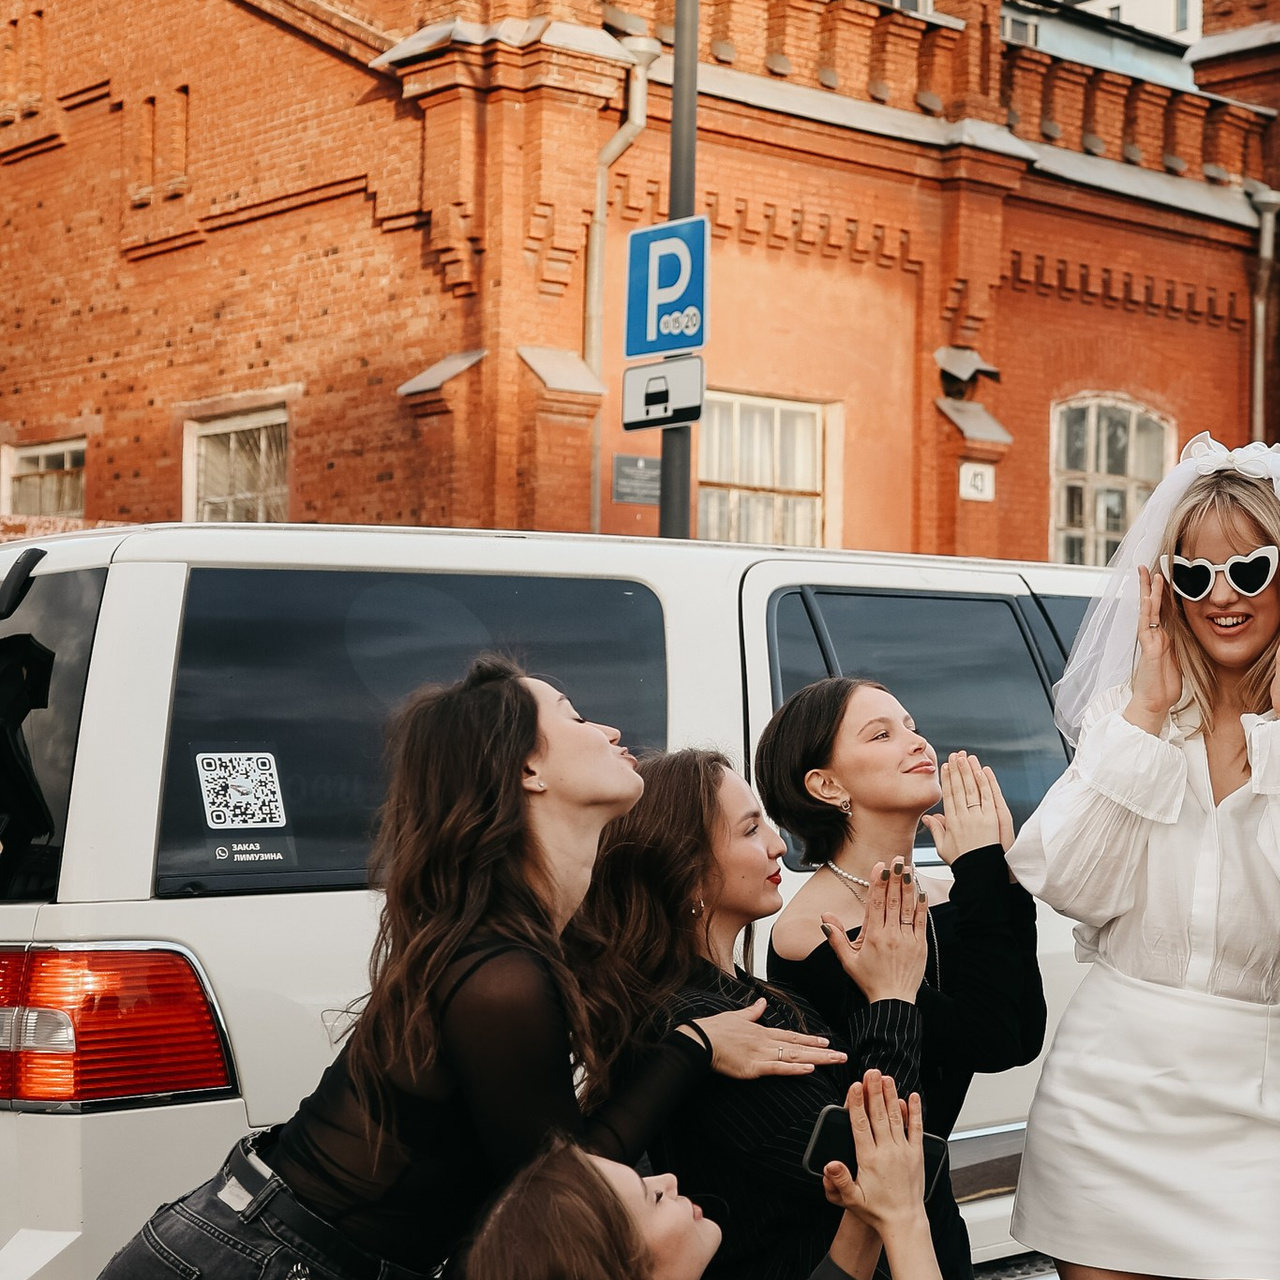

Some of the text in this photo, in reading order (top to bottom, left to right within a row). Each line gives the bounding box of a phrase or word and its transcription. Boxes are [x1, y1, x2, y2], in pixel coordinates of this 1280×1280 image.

[646, 236, 692, 342] P
[684, 312, 698, 329] 20
[231, 843, 260, 852] ЗАКАЗ
[233, 852, 283, 862] ЛИМУЗИНА
